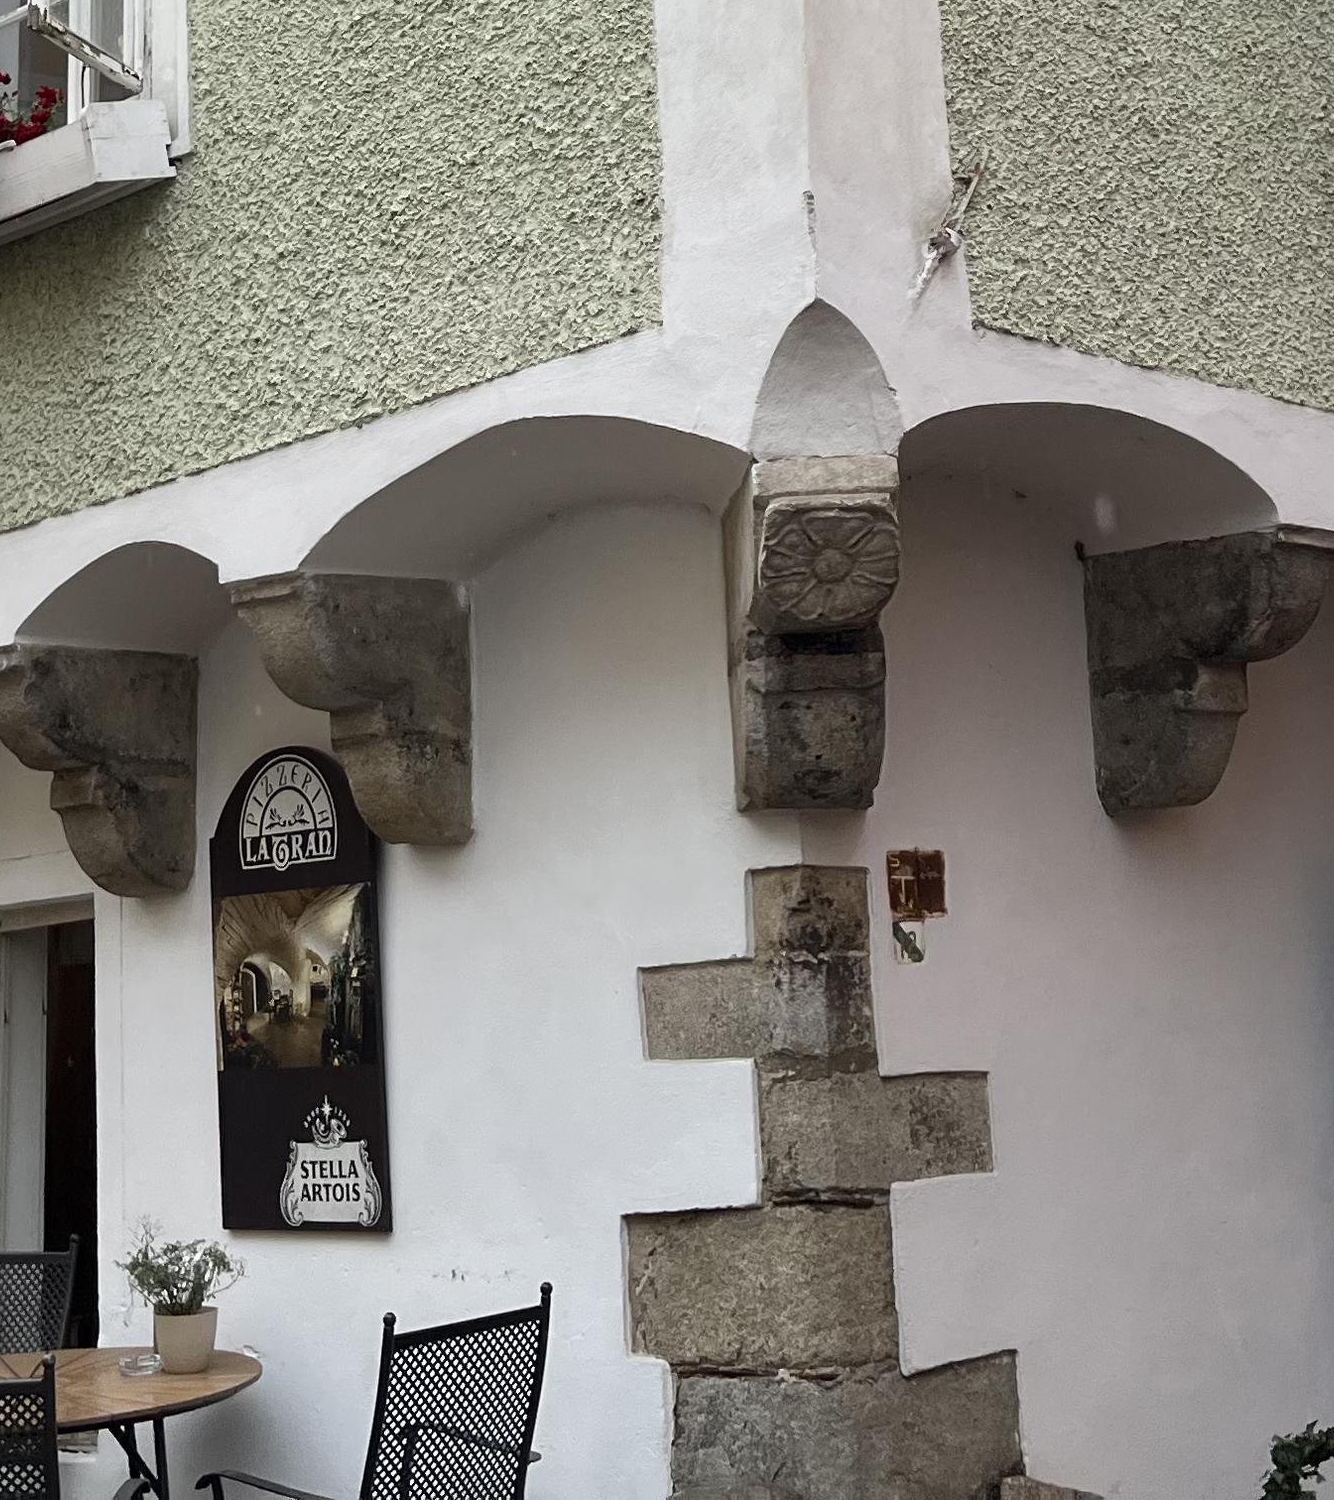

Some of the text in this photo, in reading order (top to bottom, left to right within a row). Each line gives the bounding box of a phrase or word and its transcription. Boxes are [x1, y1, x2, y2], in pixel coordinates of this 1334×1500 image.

[246, 764, 330, 827] PIZZERIA
[300, 1159, 359, 1179] STELLA
[300, 1182, 361, 1203] ARTOIS
